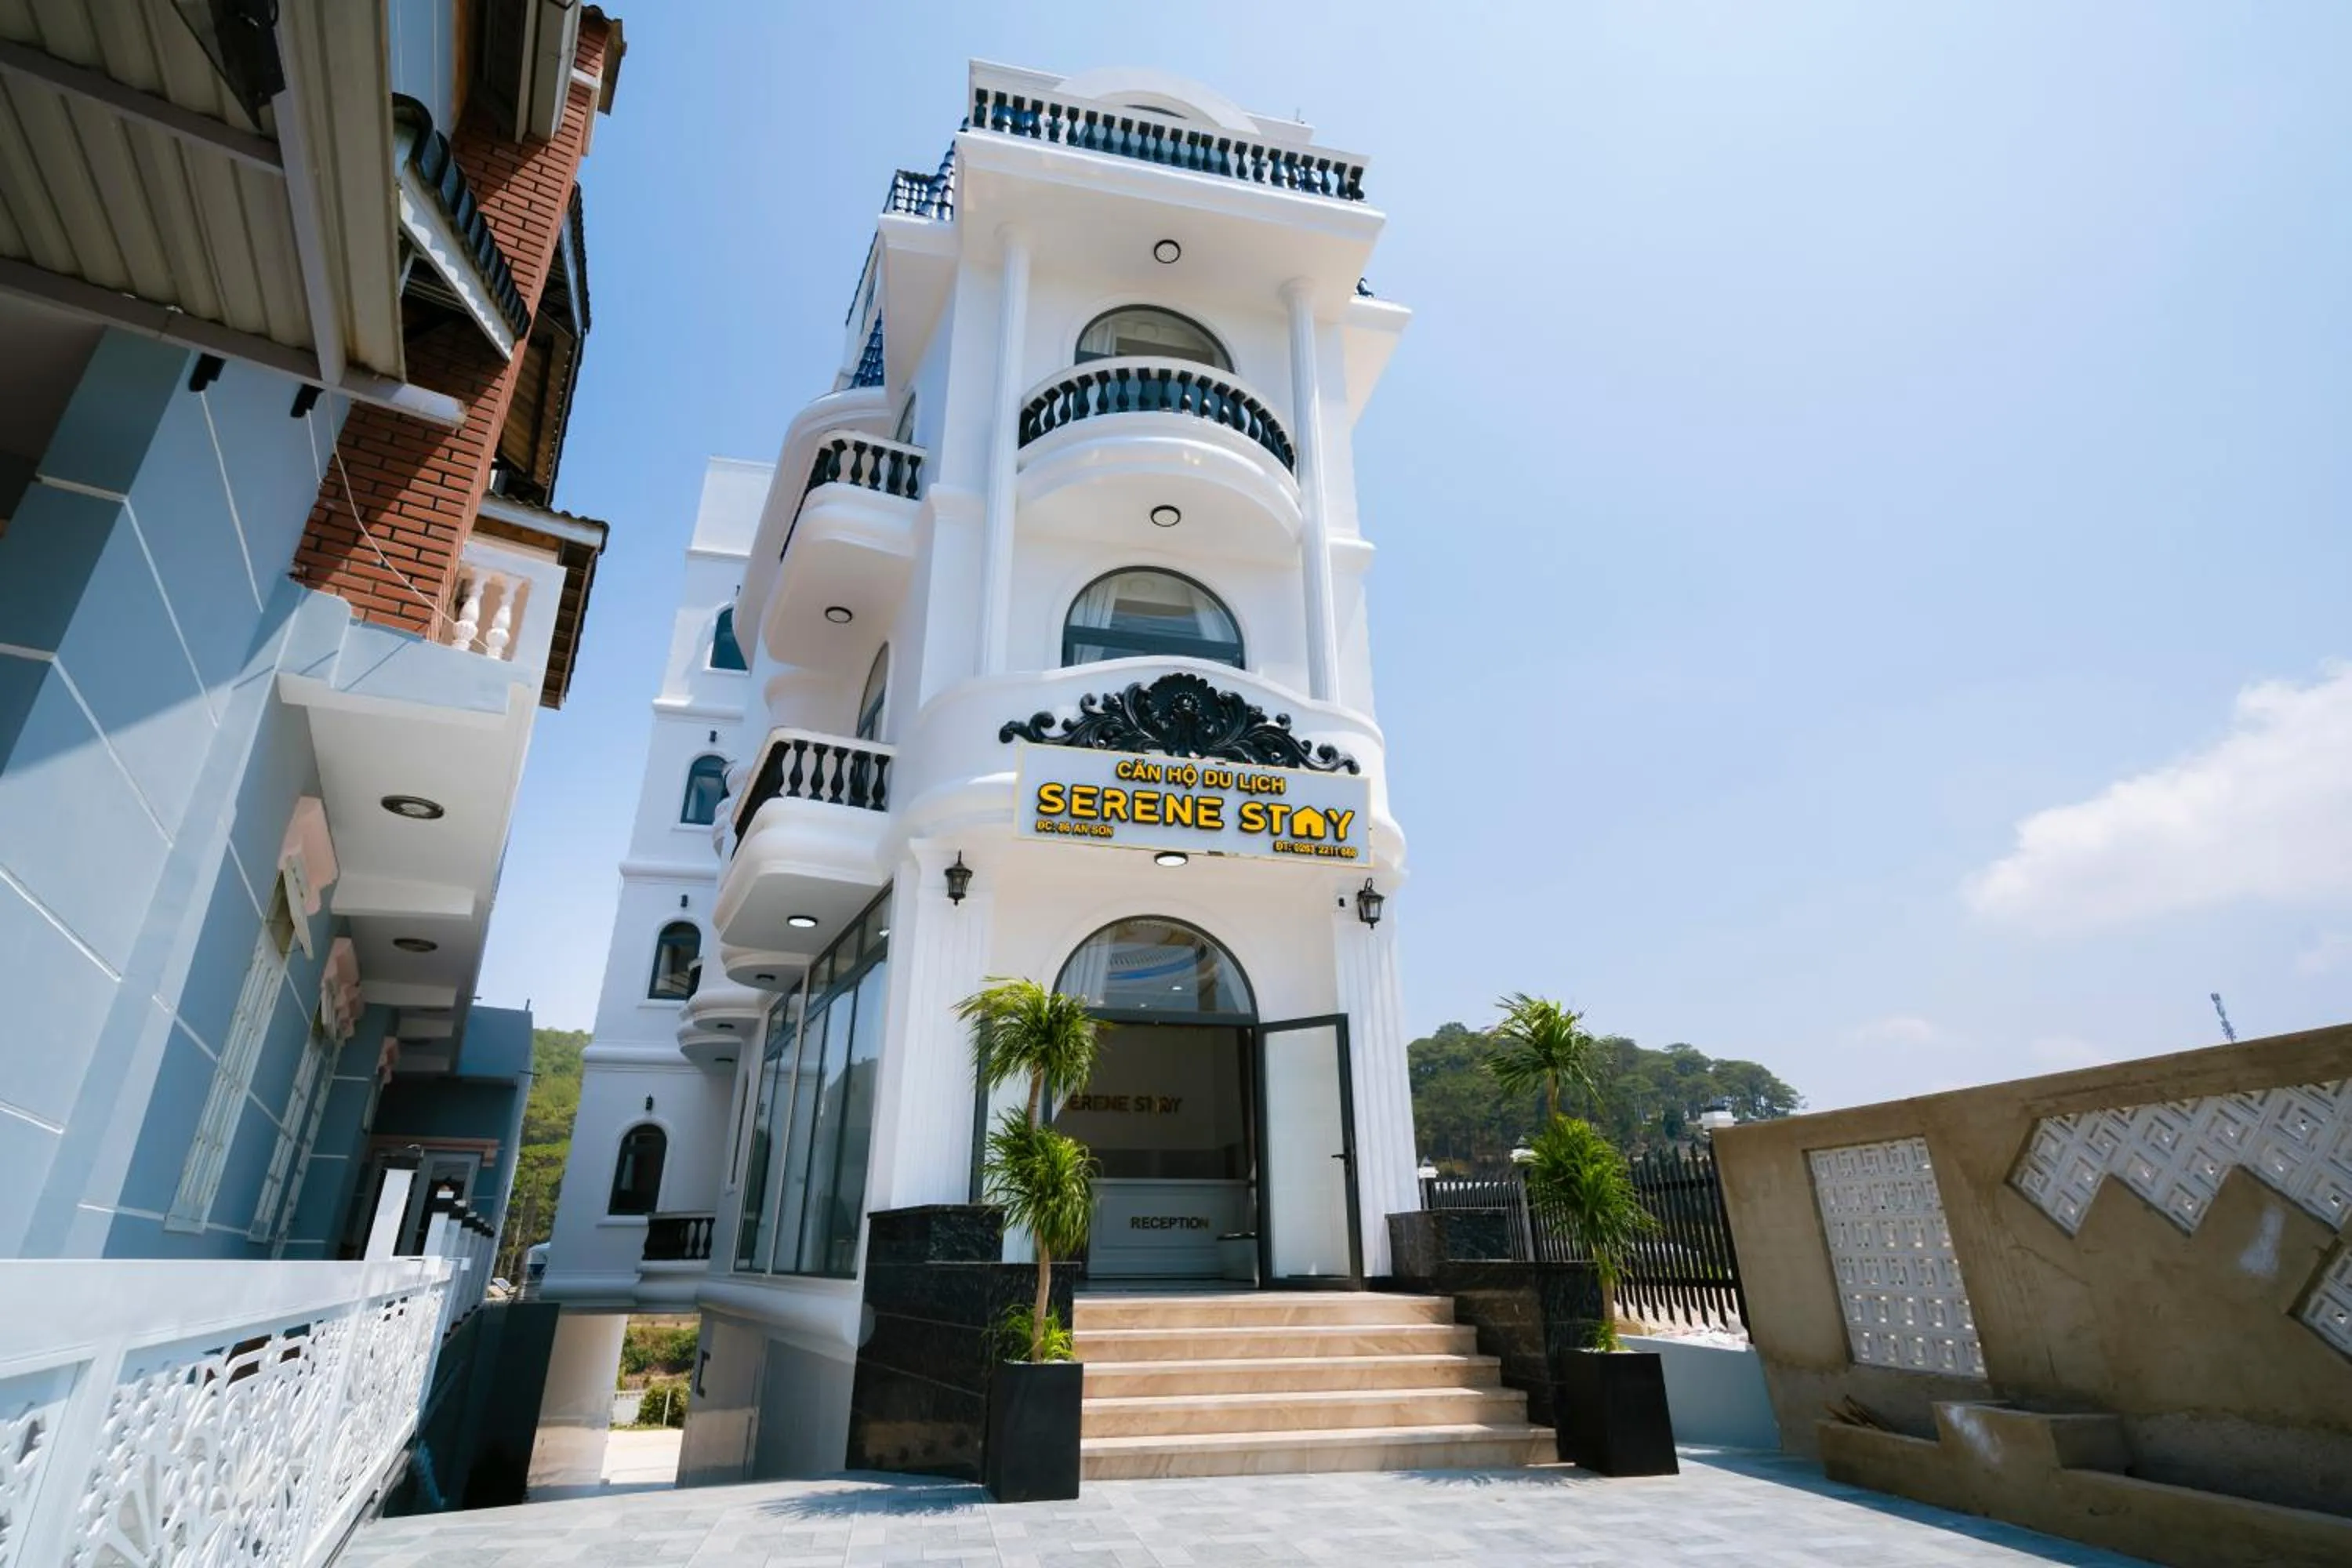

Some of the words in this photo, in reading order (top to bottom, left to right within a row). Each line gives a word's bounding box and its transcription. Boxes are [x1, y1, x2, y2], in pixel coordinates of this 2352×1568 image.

[1116, 759, 1162, 782] CĂN
[1166, 763, 1199, 788] HỘ
[1203, 768, 1232, 789] DU
[1236, 772, 1286, 795] LỊCH
[1036, 782, 1225, 829] SERENE
[1239, 800, 1356, 841] STAY
[1072, 822, 1089, 836] AN
[1131, 1216, 1210, 1230] RECEPTION
